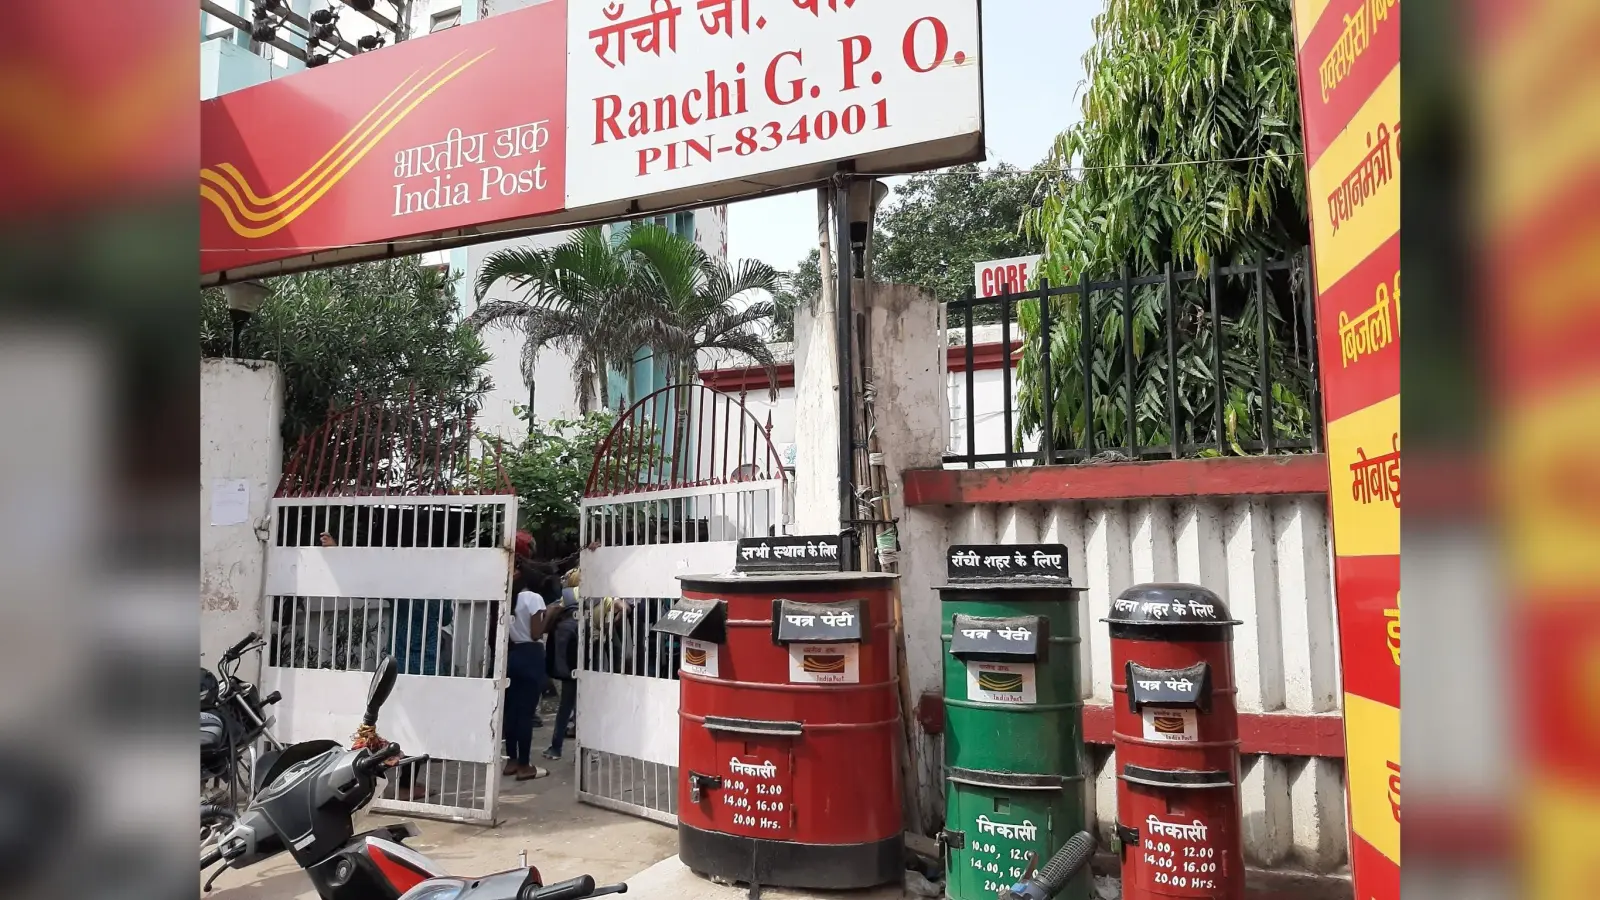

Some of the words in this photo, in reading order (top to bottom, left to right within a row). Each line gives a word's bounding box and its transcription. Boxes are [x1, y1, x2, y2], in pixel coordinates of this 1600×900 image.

[589, 0, 681, 69] राँची
[591, 61, 749, 145] Ranchi
[764, 48, 821, 106] G.
[838, 34, 883, 92] P.
[902, 16, 966, 73] O.
[635, 98, 893, 178] PIN-834001
[394, 127, 488, 179] भारतीय
[494, 119, 549, 159] डाक
[391, 177, 470, 217] India
[478, 161, 548, 201] Post
[1327, 122, 1393, 237] प्रधानमंत्री
[1338, 282, 1392, 369] बिजली
[741, 542, 770, 560] सभी
[773, 545, 806, 559] स्थान
[807, 541, 818, 557] के
[818, 541, 838, 559] लिए
[952, 551, 980, 567] राँची
[983, 555, 1011, 571] शहर
[1014, 551, 1027, 567] के
[1032, 551, 1062, 569] लिए
[786, 614, 815, 627] पत्र
[820, 611, 855, 627] पेटी
[1114, 598, 1139, 613] पटना
[1141, 602, 1170, 619] शहर
[1172, 599, 1186, 616] के
[1188, 600, 1216, 619] लिए
[961, 629, 991, 640] पत्र
[997, 626, 1032, 641] पेटी
[1137, 680, 1162, 691] पत्र
[1164, 677, 1194, 692] पेटी
[729, 757, 777, 779] निकासी
[724, 779, 749, 794] 10.00,
[756, 784, 782, 795] 12.00
[723, 794, 751, 810] 14.00,
[756, 800, 784, 812] 16.00
[733, 813, 756, 827] 20.00
[760, 817, 781, 829] Hrs.
[975, 814, 1037, 842] निकासी
[1145, 814, 1208, 842] निकासी
[972, 840, 1001, 860] 10.00,
[1144, 838, 1175, 857] 10.00,
[1183, 846, 1214, 858] 12.00
[970, 857, 1004, 878] 14.00,
[1144, 852, 1177, 873] 14.00,
[1183, 861, 1217, 873] 16.00
[1155, 871, 1187, 888] 20.00
[1191, 877, 1217, 889] Hrs.
